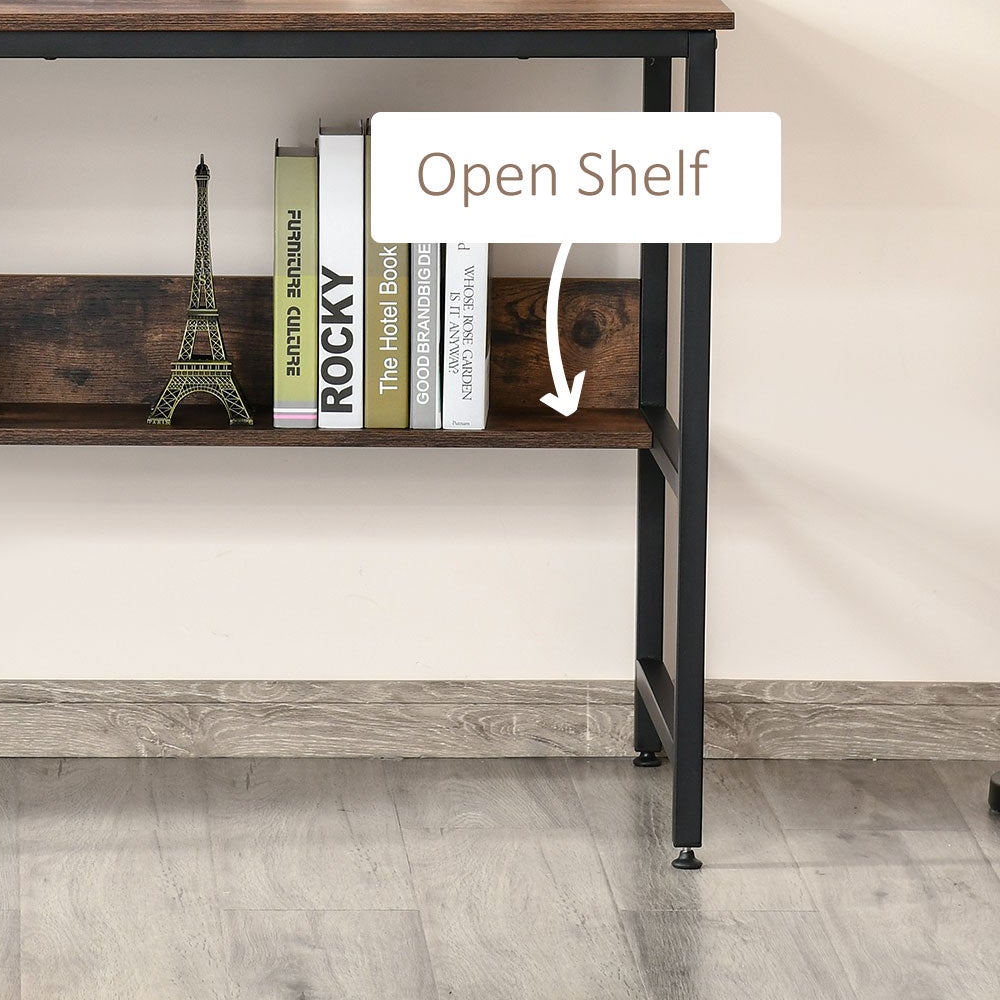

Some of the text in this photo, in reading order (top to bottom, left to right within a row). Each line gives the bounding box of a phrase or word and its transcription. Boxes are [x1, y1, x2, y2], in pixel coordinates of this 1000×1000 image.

[378, 245, 398, 395] The Hotel Book
[463, 265, 475, 311] WHOSE
[286, 306, 301, 377] CULTURE
[320, 265, 354, 413] ROCKY
[448, 292, 461, 374] IS IT ANYWAY?
[462, 315, 474, 346] ROSE
[461, 349, 473, 401] GARDEN
